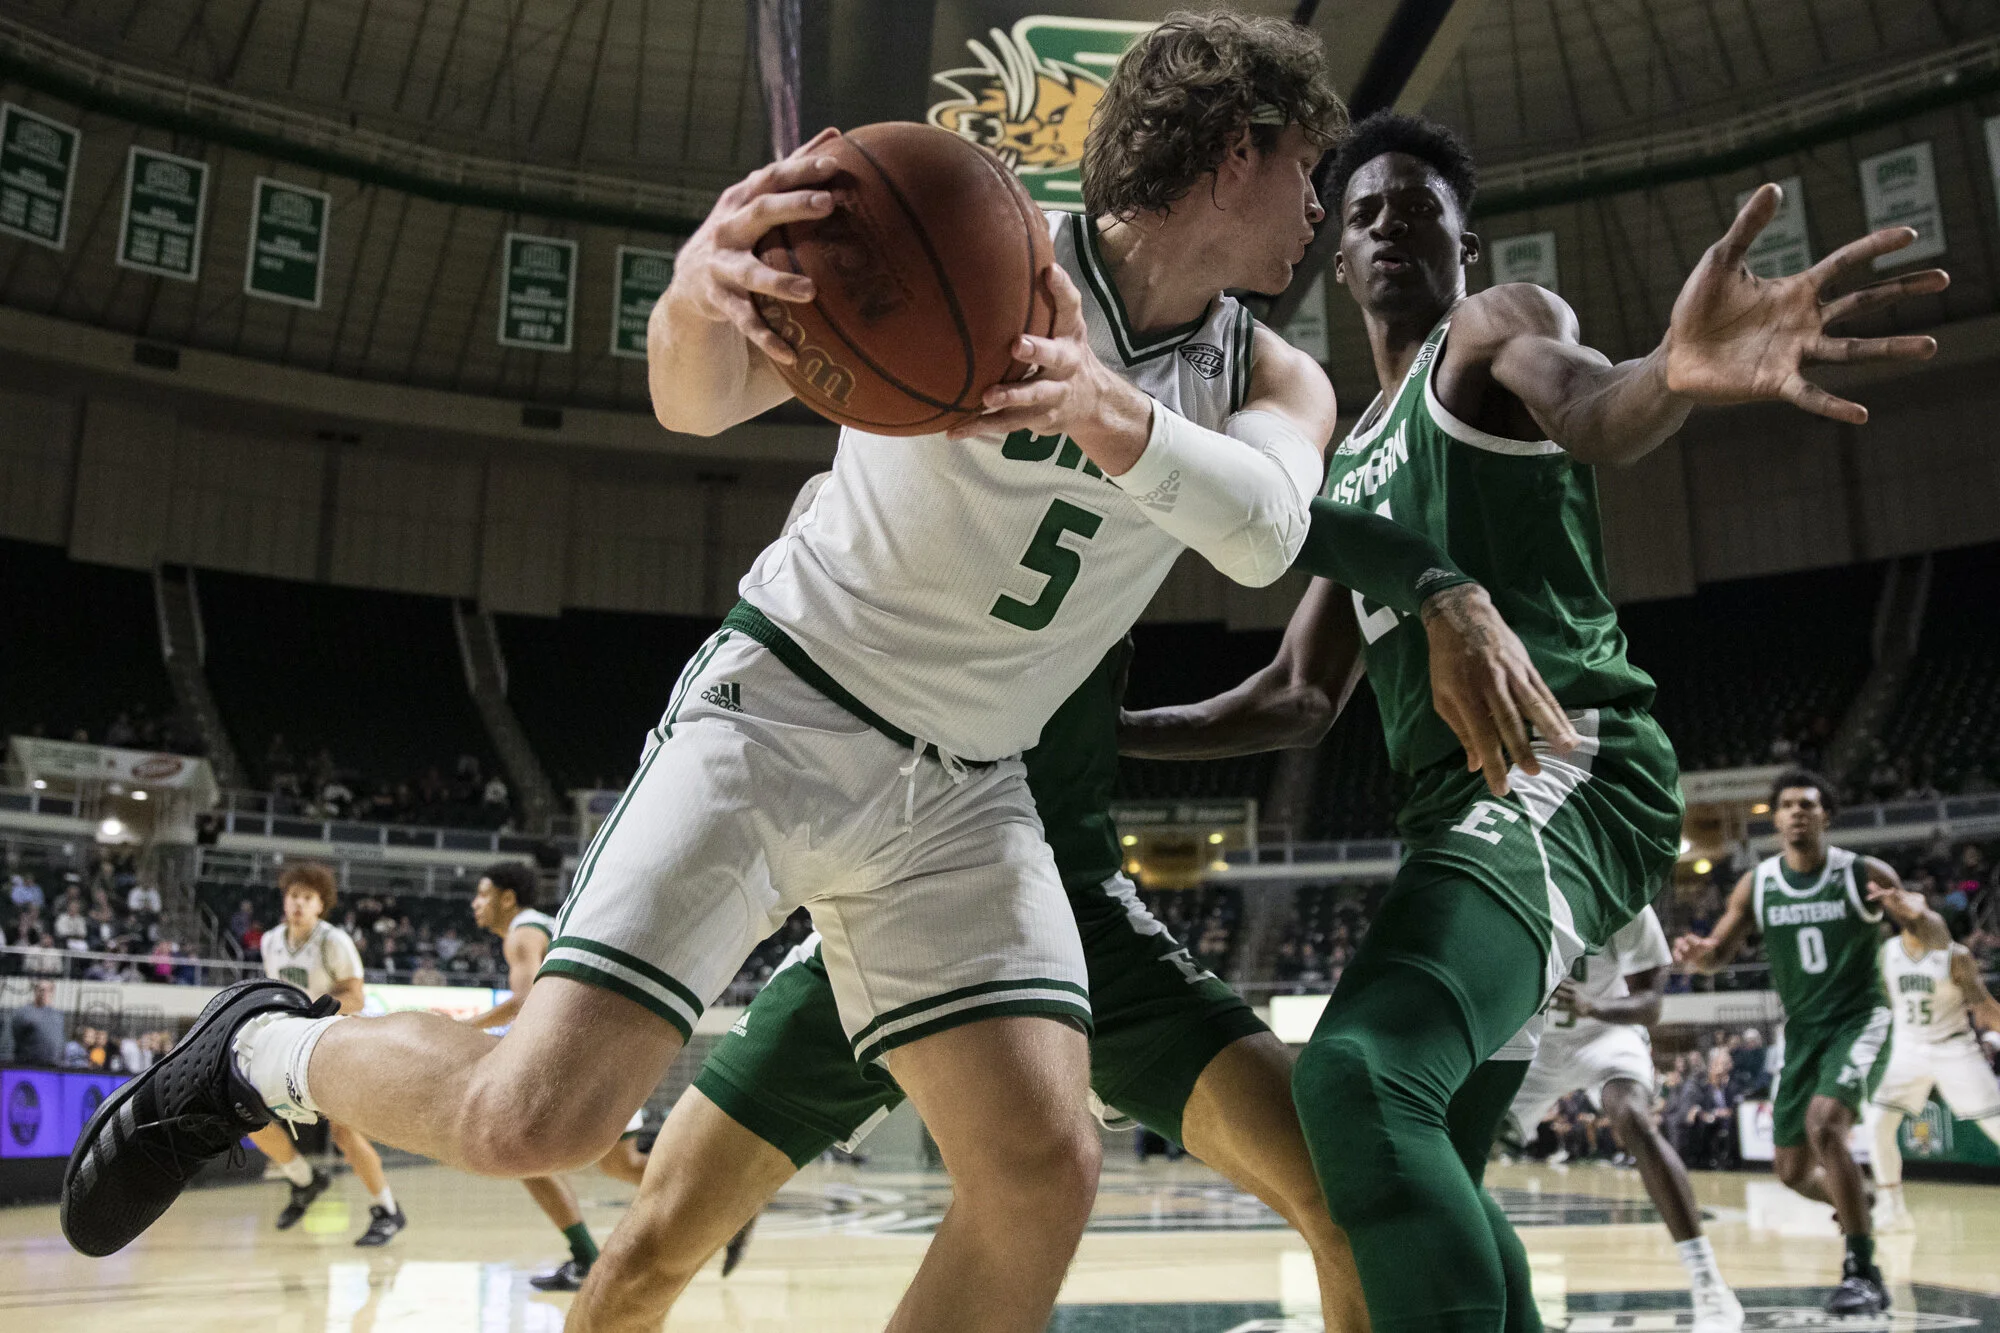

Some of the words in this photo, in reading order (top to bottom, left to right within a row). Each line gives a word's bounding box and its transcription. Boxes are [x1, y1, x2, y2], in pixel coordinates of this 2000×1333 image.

[988, 497, 1104, 632] 5
[1449, 800, 1520, 846] E
[1767, 899, 1847, 927] EASTERN
[1797, 926, 1828, 974] 0
